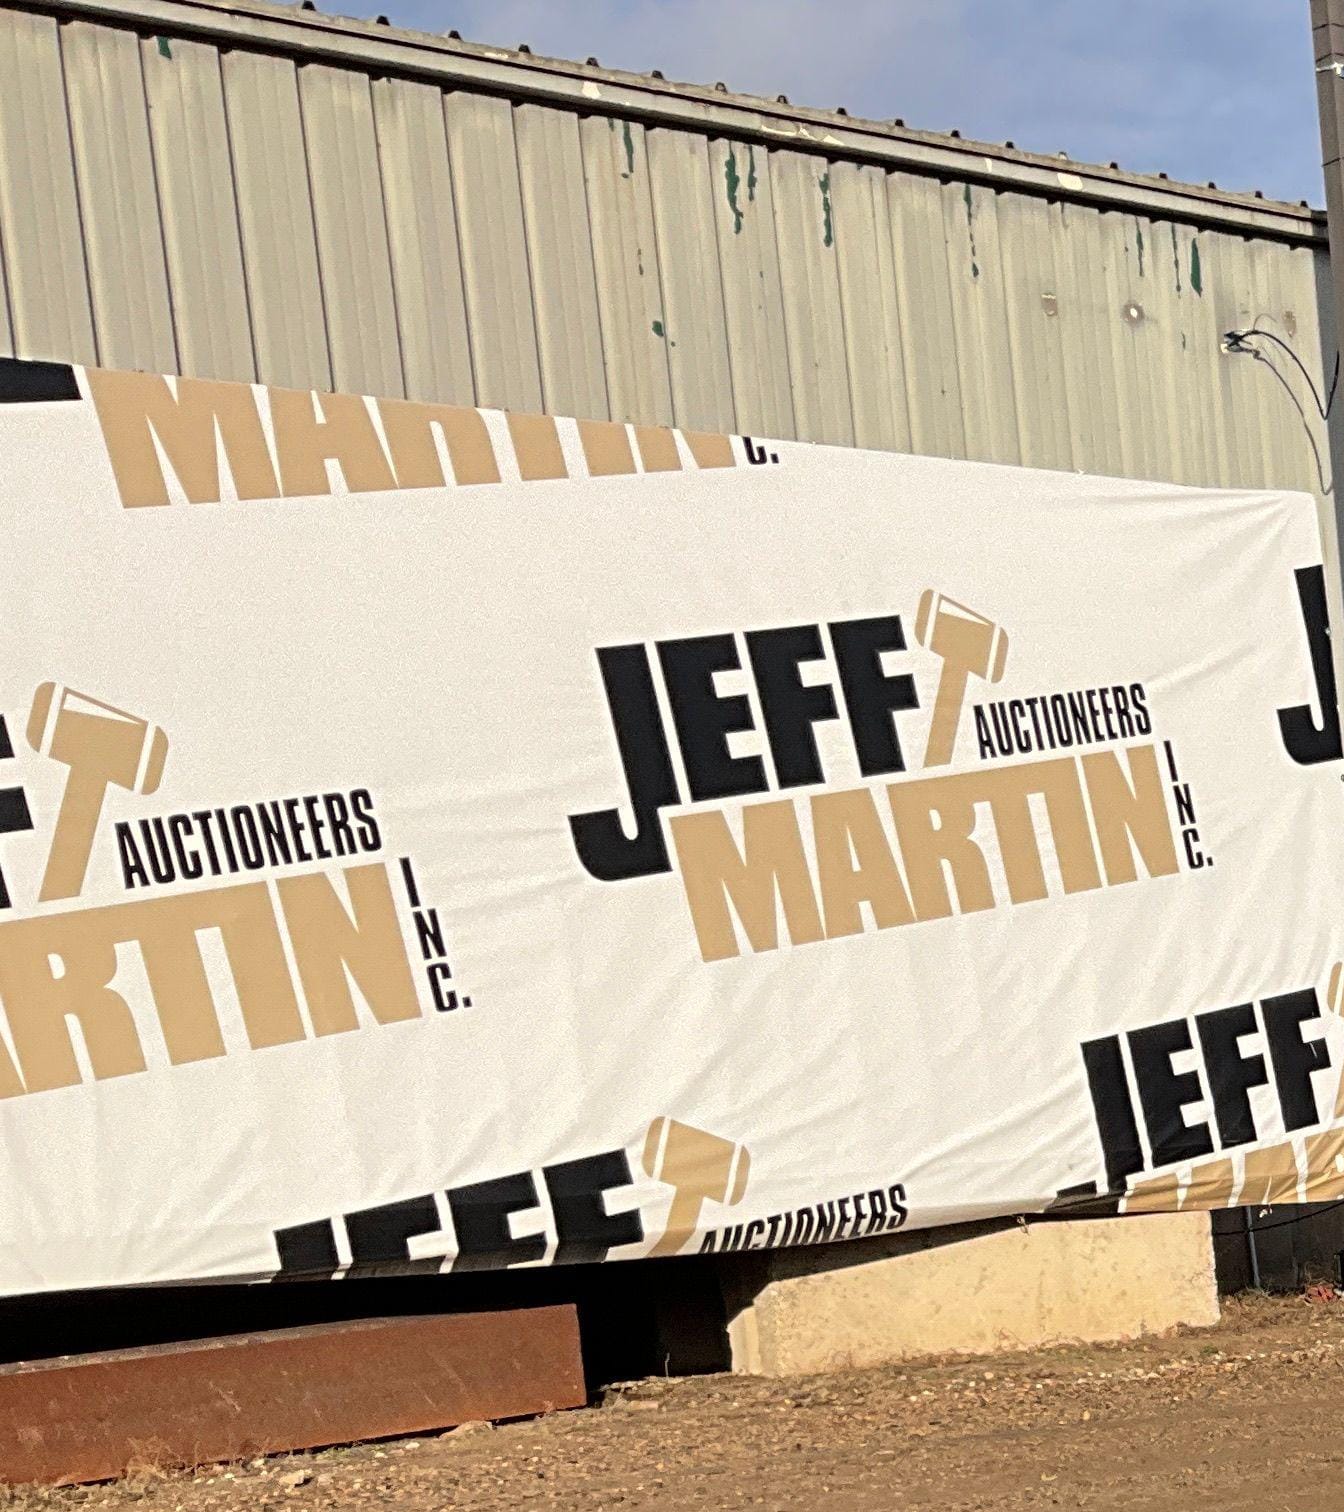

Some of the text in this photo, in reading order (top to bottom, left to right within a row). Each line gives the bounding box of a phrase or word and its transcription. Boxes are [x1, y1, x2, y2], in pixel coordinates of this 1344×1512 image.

[568, 614, 921, 882] JEFF
[974, 683, 1152, 759] AUCTIONEERS
[114, 789, 383, 889] AUCTIONEERS
[668, 744, 1180, 962] MARTIN
[0, 861, 424, 1101] RTIN
[1046, 987, 1332, 1213] JEFF
